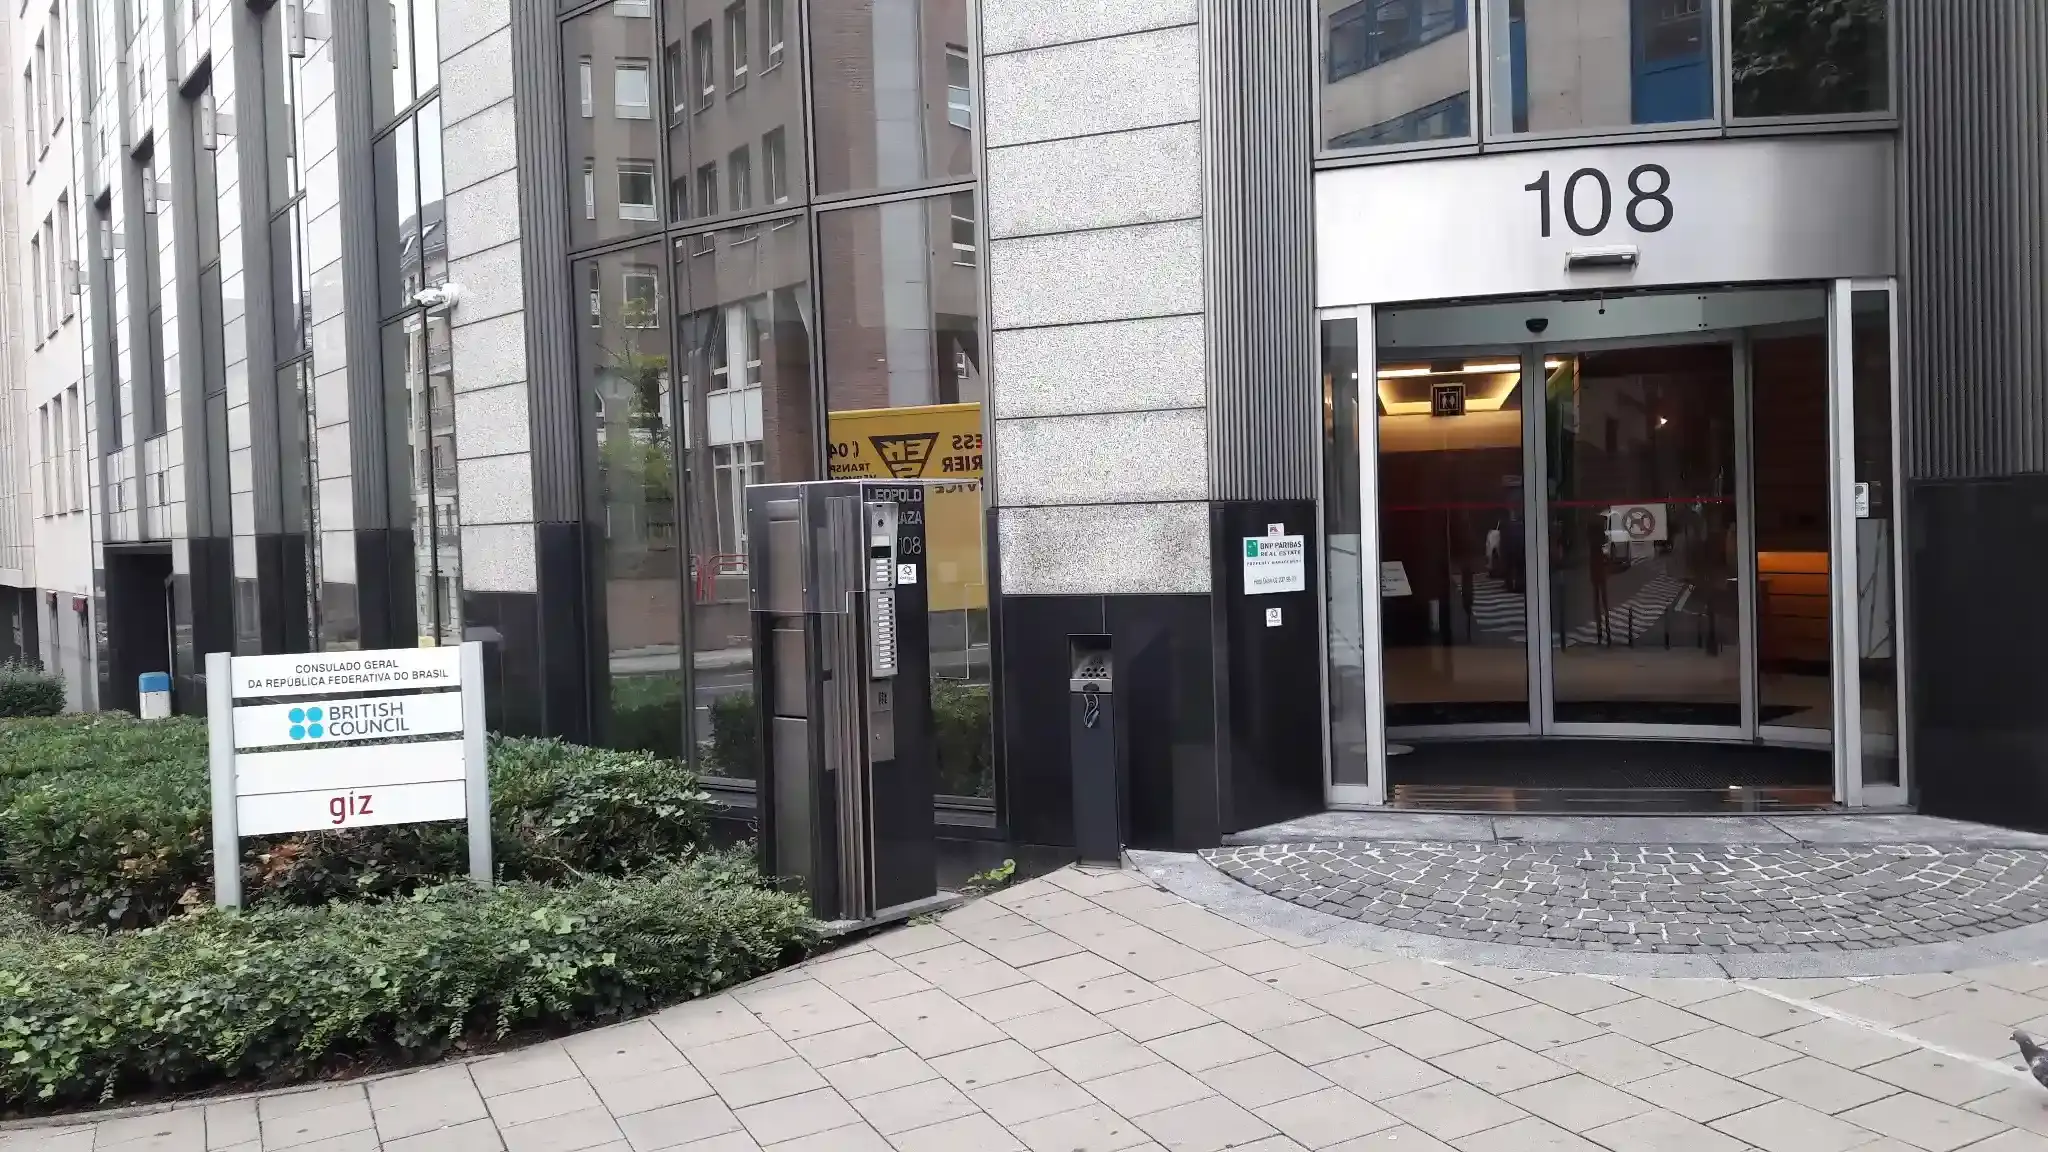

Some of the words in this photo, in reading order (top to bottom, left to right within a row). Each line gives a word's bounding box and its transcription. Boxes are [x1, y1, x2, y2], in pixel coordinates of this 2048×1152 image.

[1525, 164, 1673, 237] 108
[867, 489, 922, 502] LEOPOLD
[899, 536, 922, 554] 108
[1275, 541, 1302, 549] PARIBAS
[295, 662, 361, 674] CONSULADO
[364, 660, 399, 670] GERAL
[248, 679, 262, 689] DA
[266, 676, 325, 688] REPÚBLICA
[328, 673, 391, 685] FEDERATIVA
[394, 671, 409, 681] DO
[412, 669, 448, 680] BRASIL
[329, 702, 404, 720] BRITISH
[329, 718, 410, 736] COUNCIL
[330, 790, 373, 824] giz
